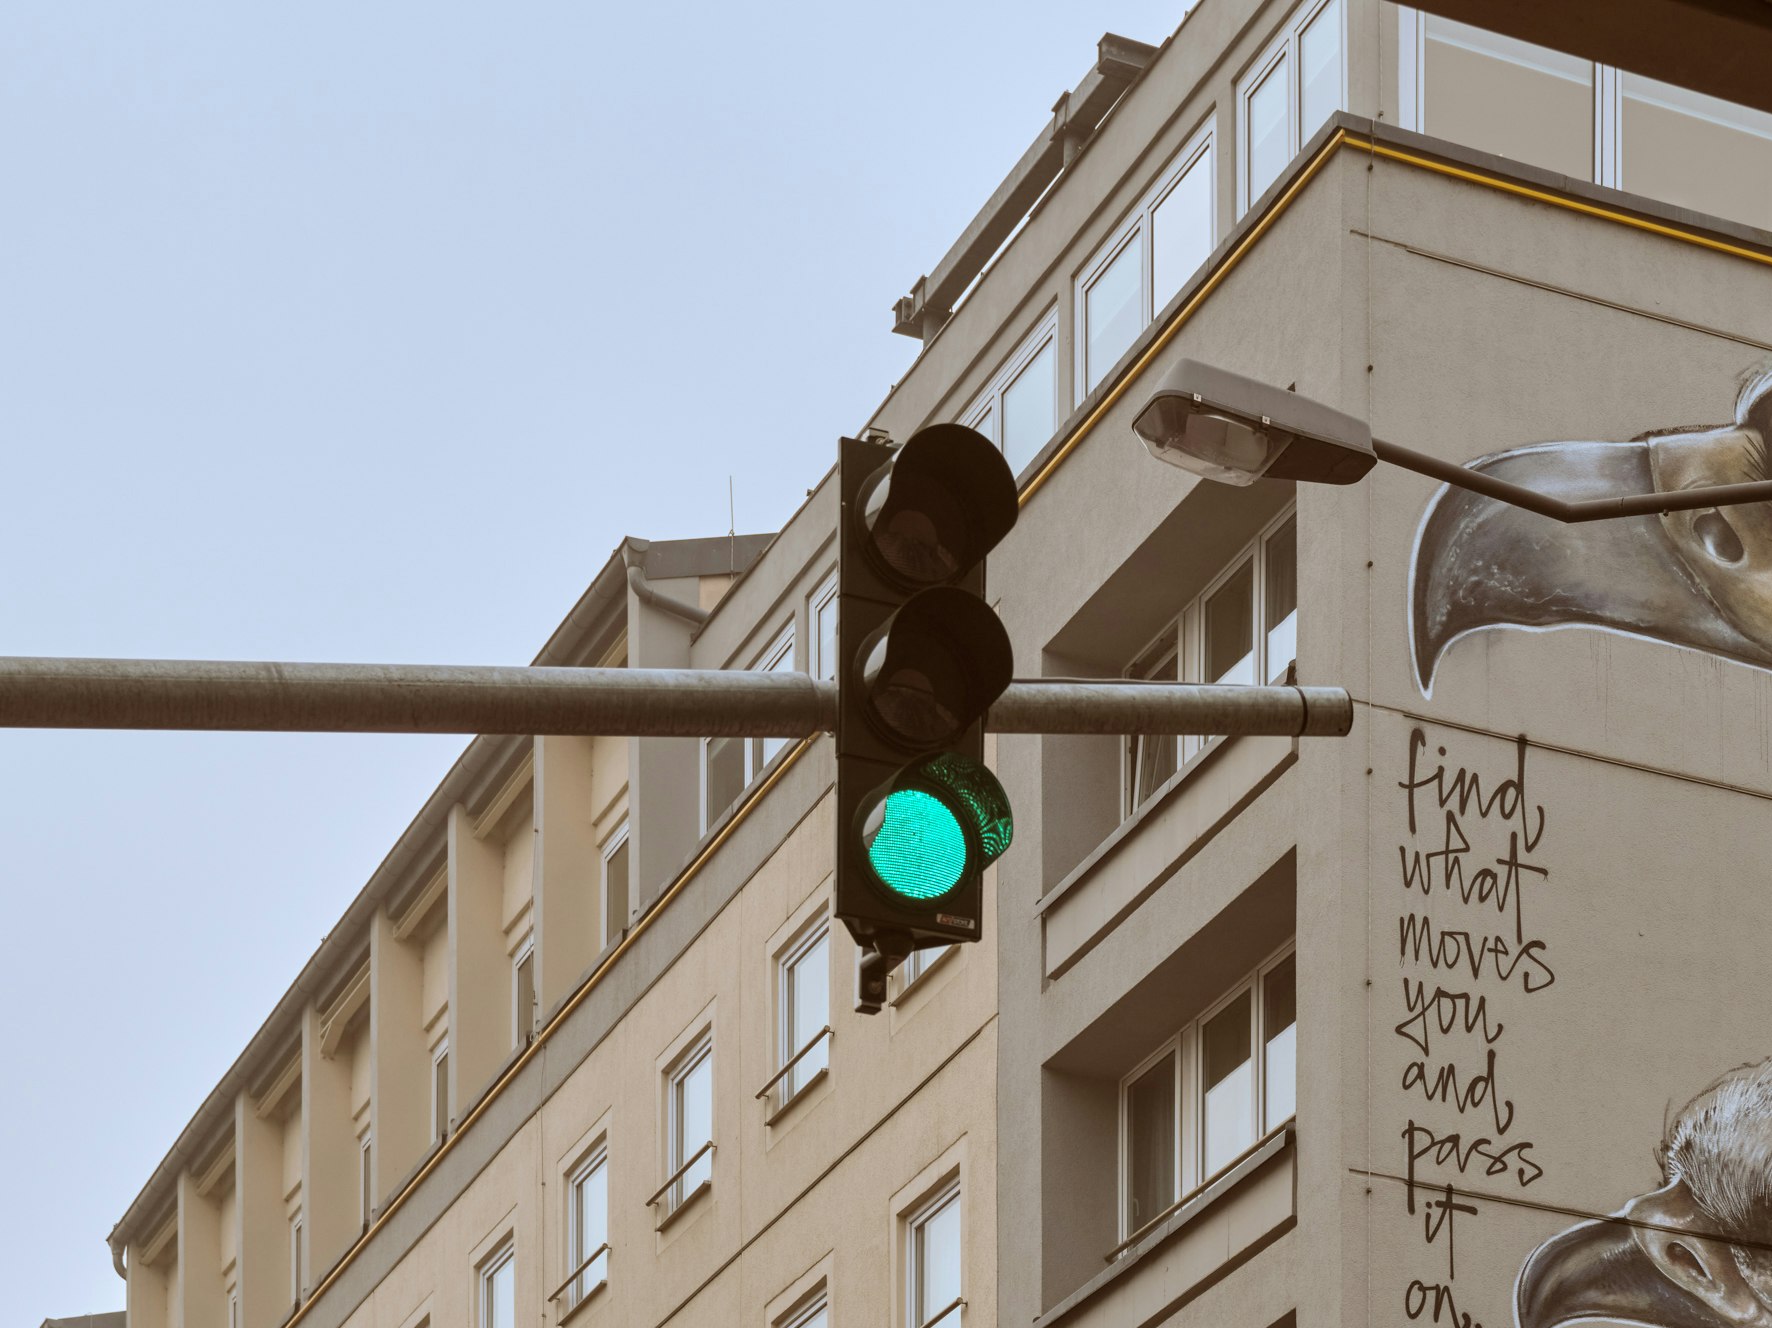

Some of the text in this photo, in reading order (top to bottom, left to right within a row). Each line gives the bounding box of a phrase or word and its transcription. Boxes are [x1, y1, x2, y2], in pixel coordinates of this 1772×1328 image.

[1397, 727, 1544, 852] find
[1398, 810, 1548, 944] what
[1400, 913, 1555, 993] moves
[1395, 977, 1503, 1056] you
[1402, 1049, 1513, 1134] and
[1402, 1119, 1544, 1215] pass
[1425, 1184, 1478, 1280] it
